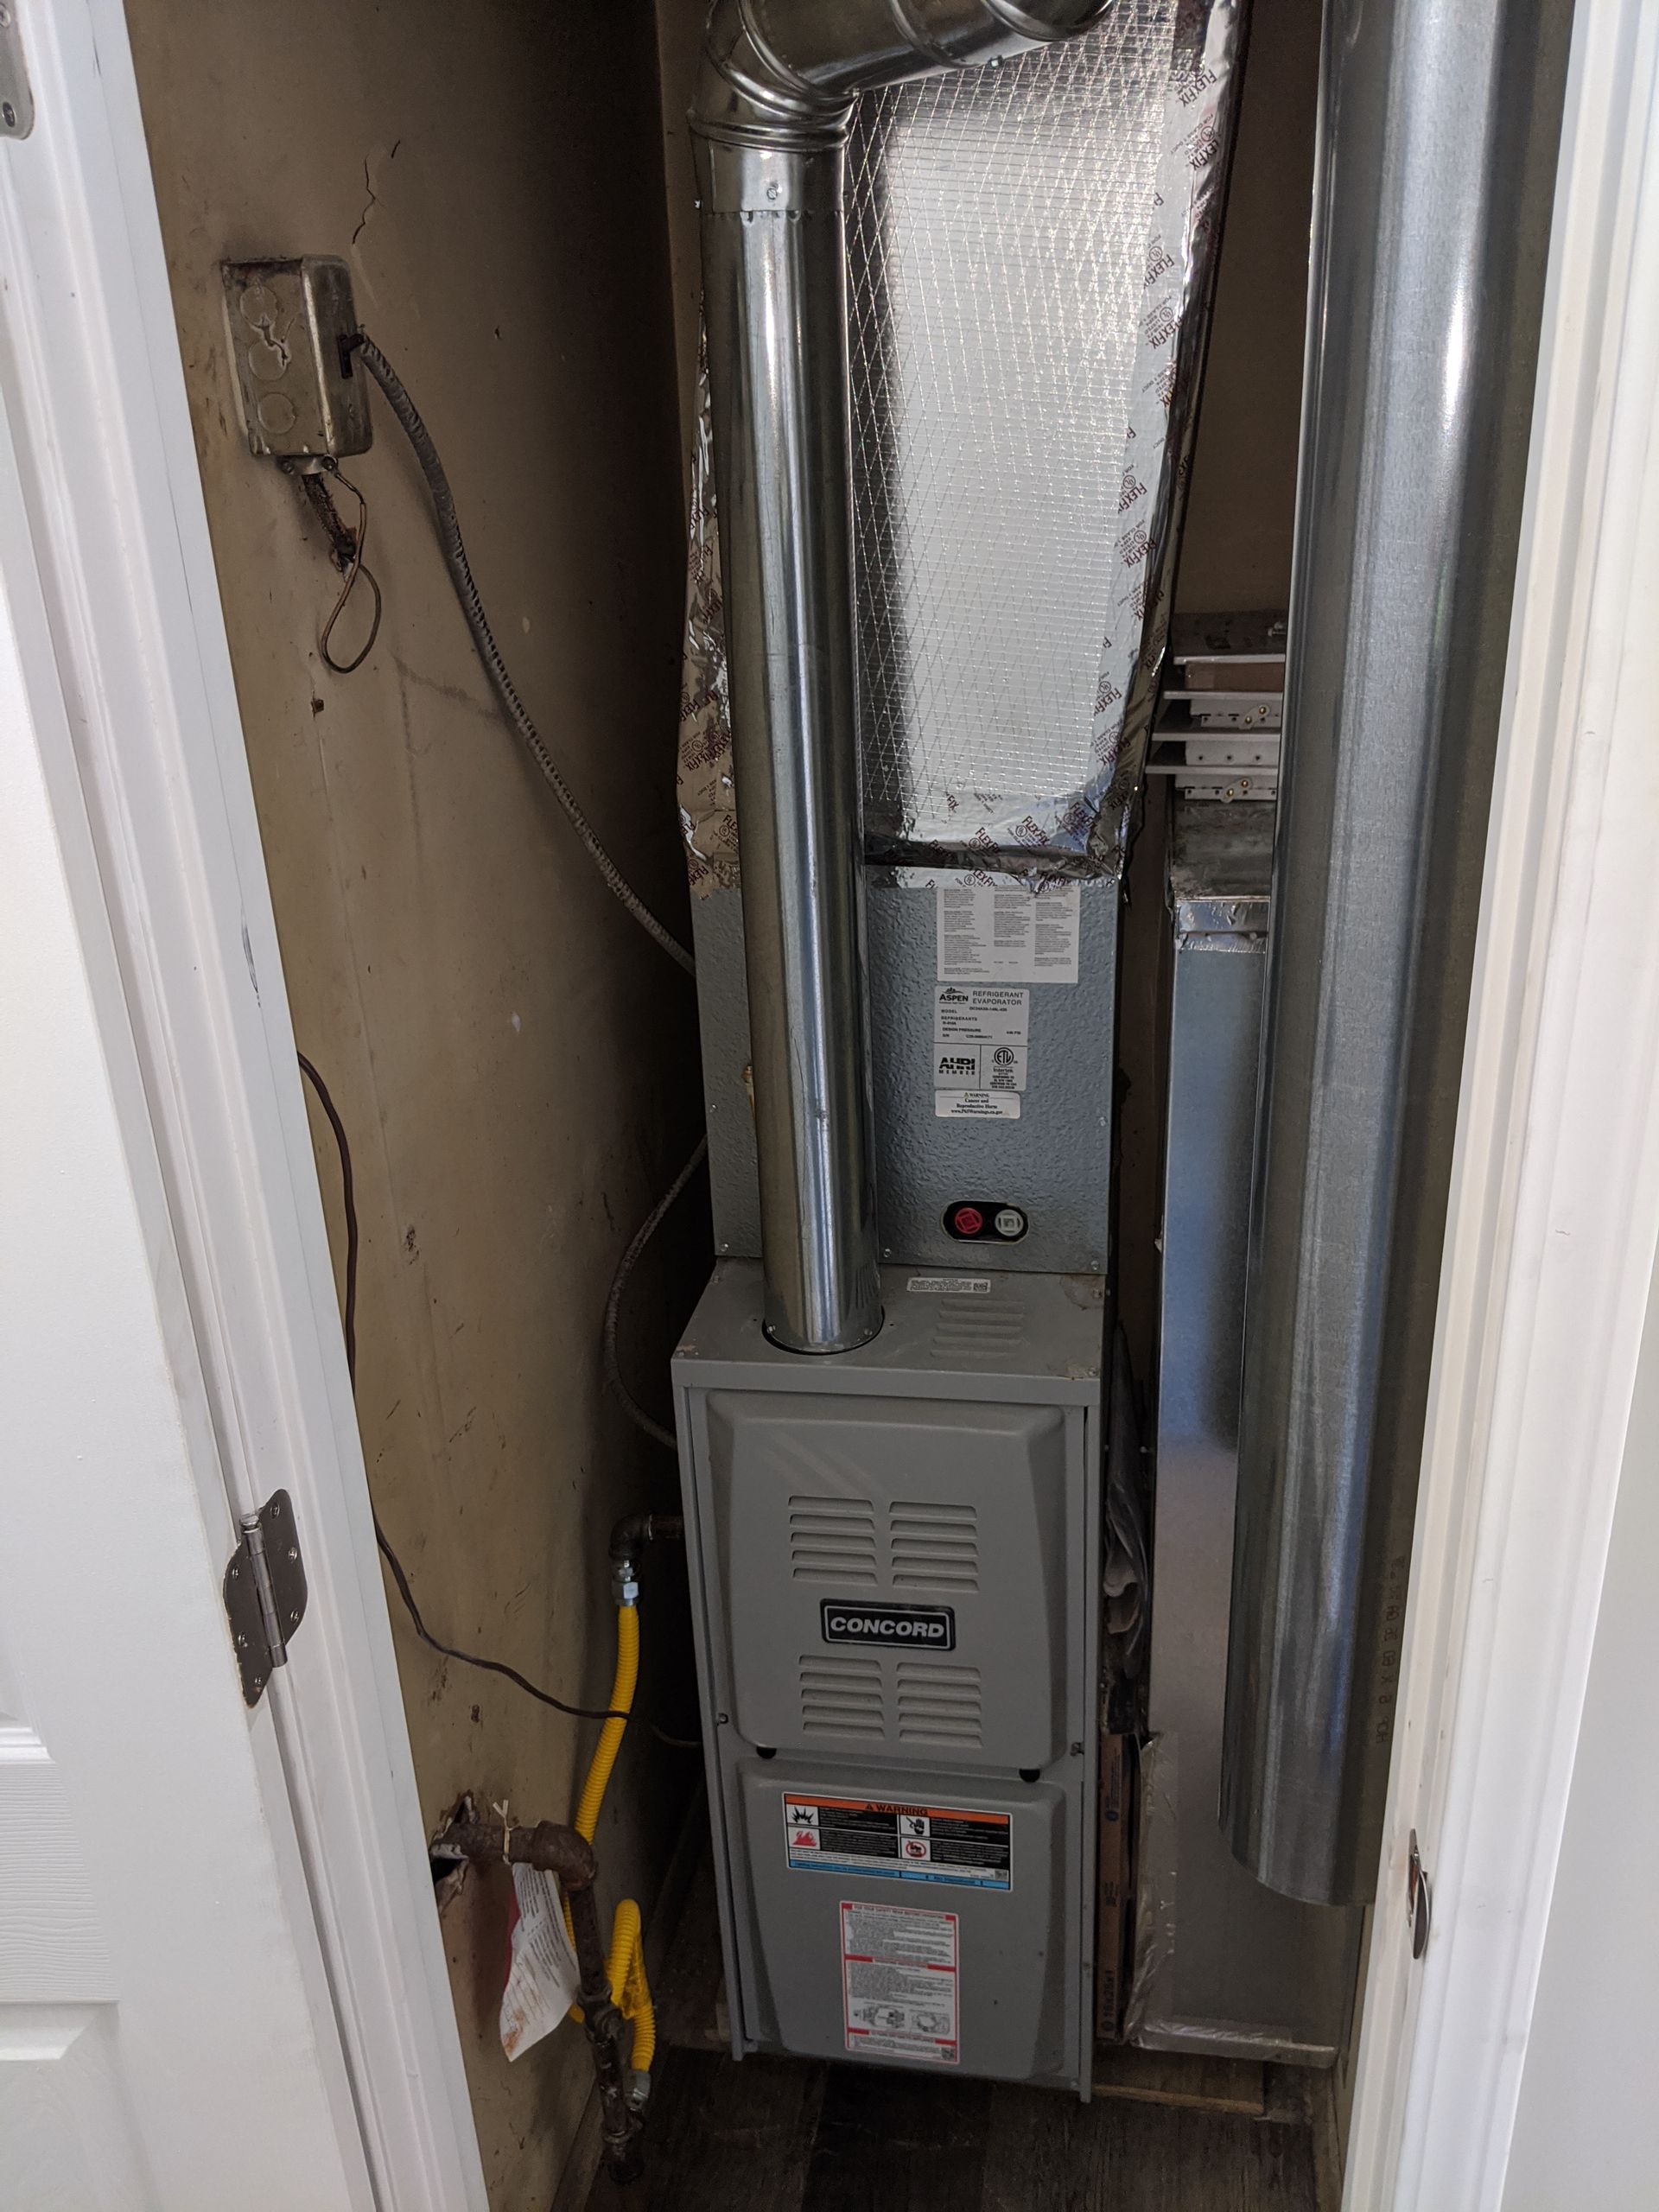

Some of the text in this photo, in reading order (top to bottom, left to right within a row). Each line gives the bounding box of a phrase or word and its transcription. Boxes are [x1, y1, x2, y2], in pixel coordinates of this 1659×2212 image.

[1179, 69, 1217, 107] FLEXFIX
[1190, 139, 1218, 170] LEXFIX
[1124, 537, 1157, 569] FLEXFIX
[830, 1617, 944, 1637] CONCORD
[876, 1803, 927, 1815] WARNING
